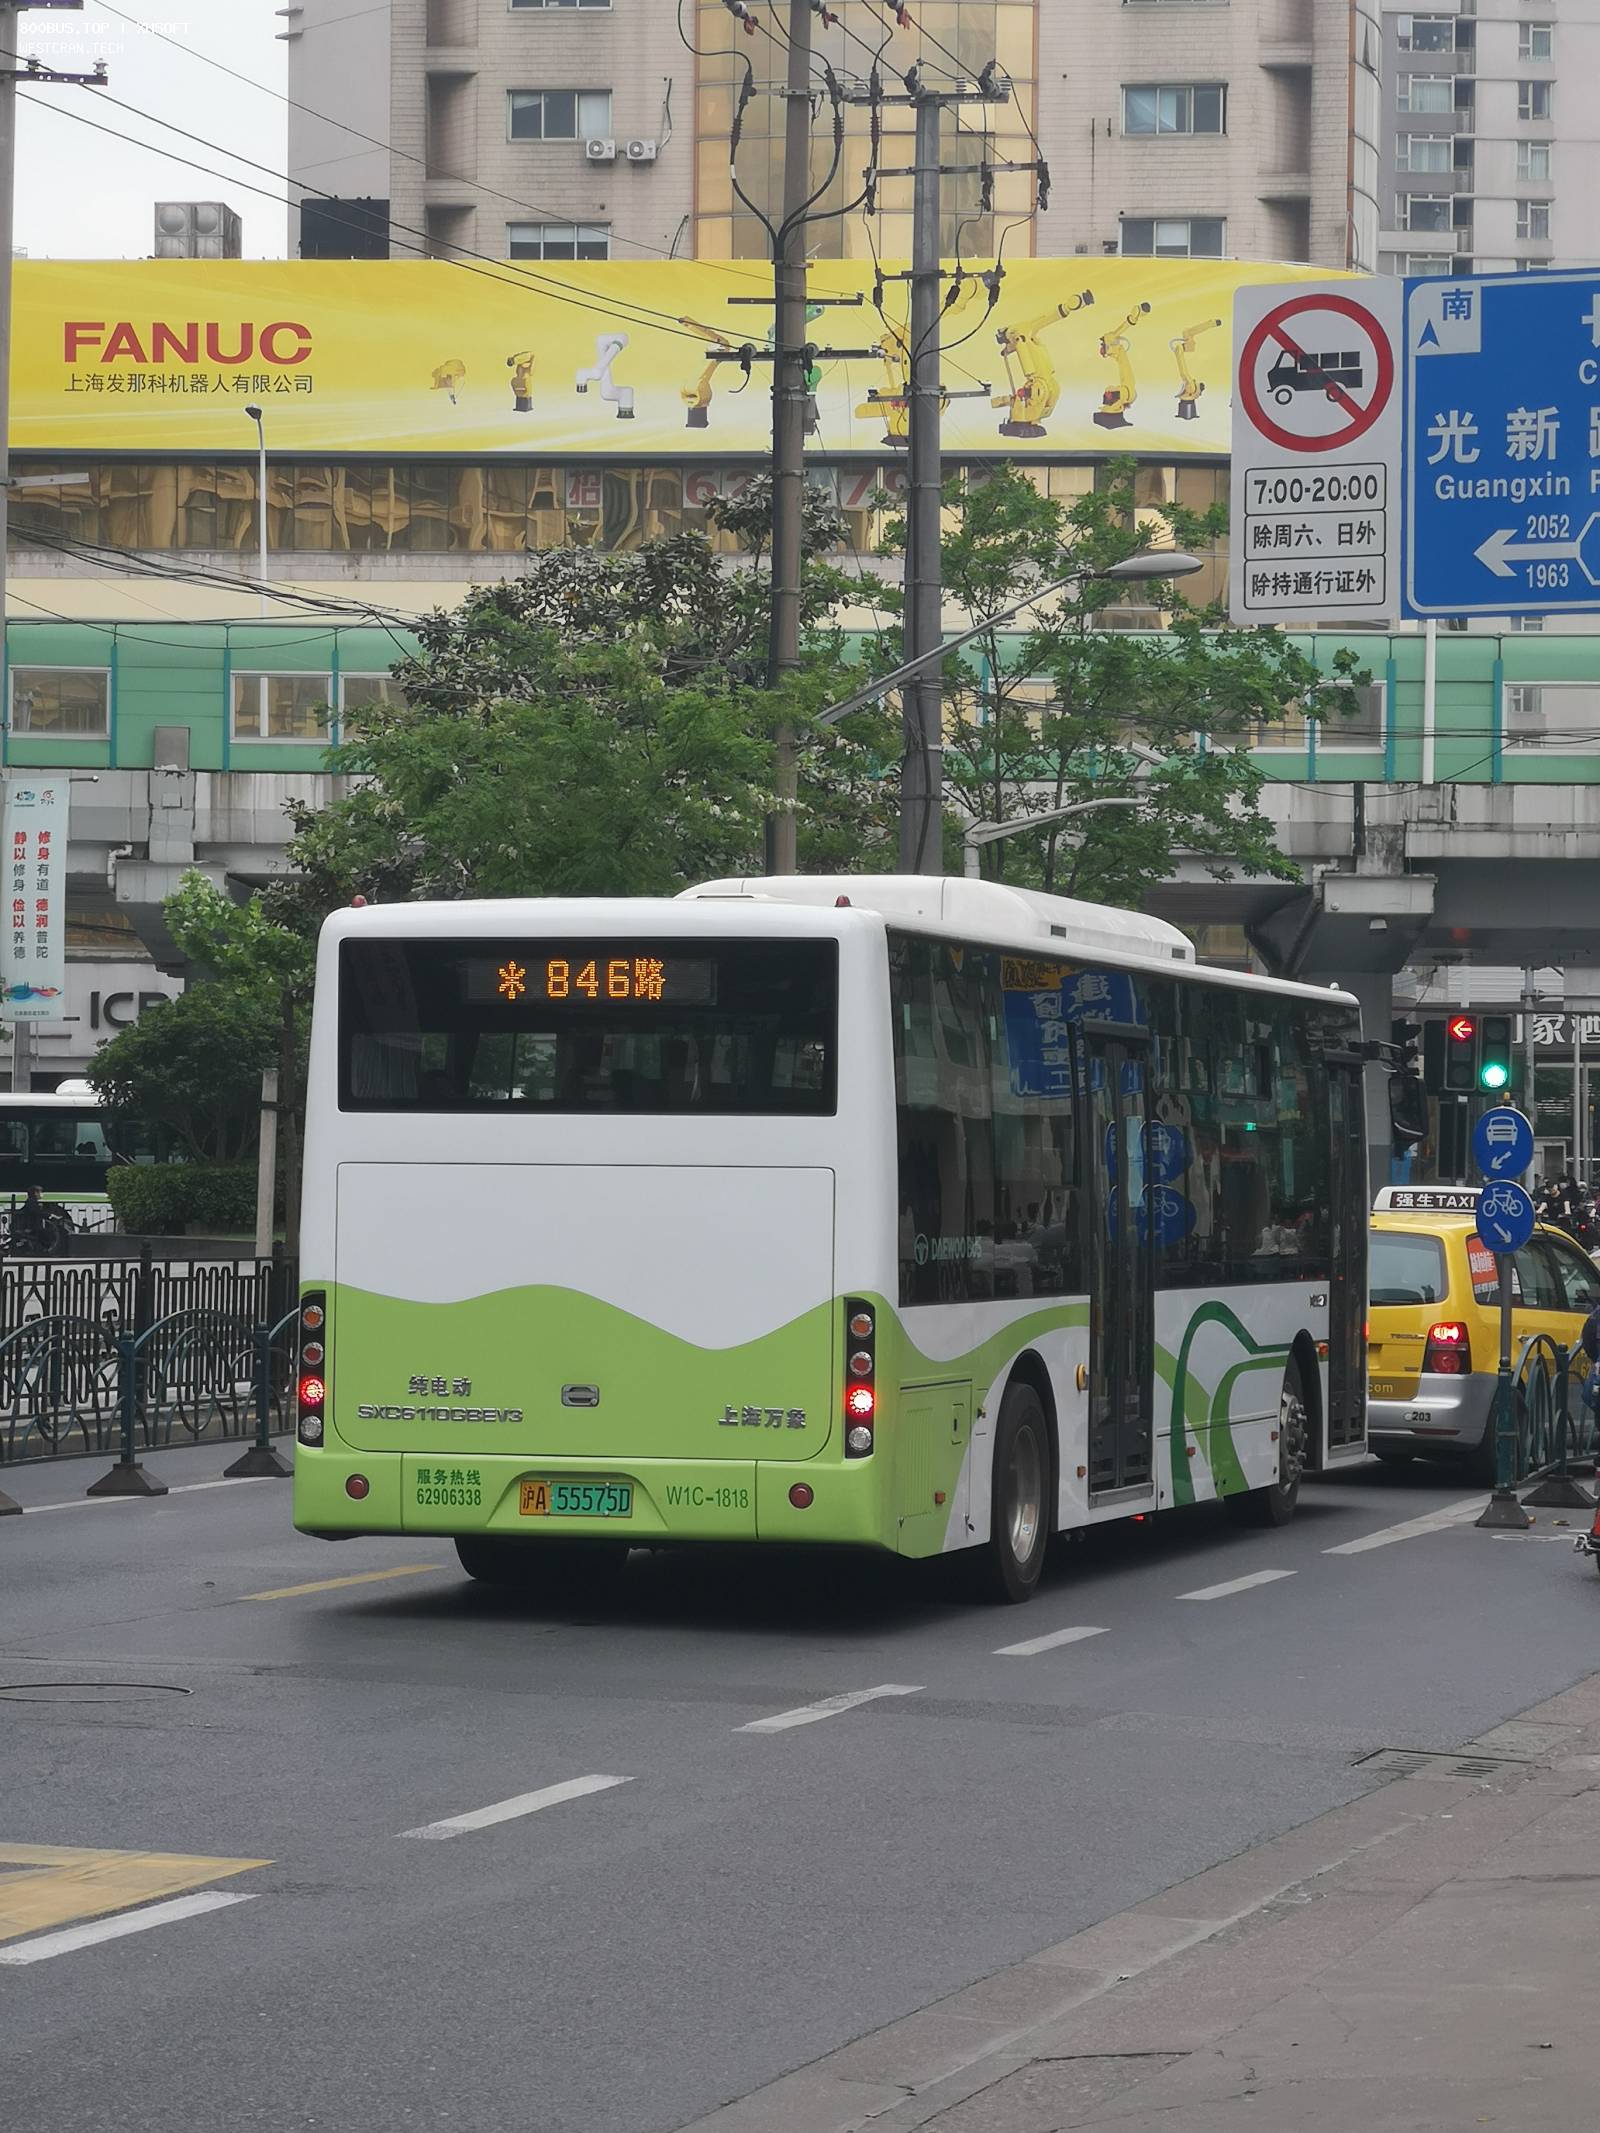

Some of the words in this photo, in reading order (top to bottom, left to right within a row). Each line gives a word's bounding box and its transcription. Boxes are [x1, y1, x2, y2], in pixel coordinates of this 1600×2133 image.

[1441, 288, 1474, 321] 南
[64, 322, 313, 364] FANUC
[64, 373, 313, 393] 上海发那科机器人有限公司
[1253, 474, 1378, 505] 7:00-20:00
[1435, 472, 1570, 503] Guangxin
[1252, 520, 1376, 549] 除周六、日外
[1526, 514, 1570, 539] 2052
[1252, 569, 1376, 597] 除持通行证外
[1526, 564, 1569, 588] 1963
[1396, 1193, 1434, 1207] 强生
[1436, 1195, 1475, 1208] TAXI
[408, 1375, 472, 1397] 纯电动
[718, 1404, 806, 1429] 上海万象
[417, 1468, 481, 1486] 服务热线
[416, 1488, 481, 1507] 62906338
[666, 1485, 749, 1509] W1C-1818
